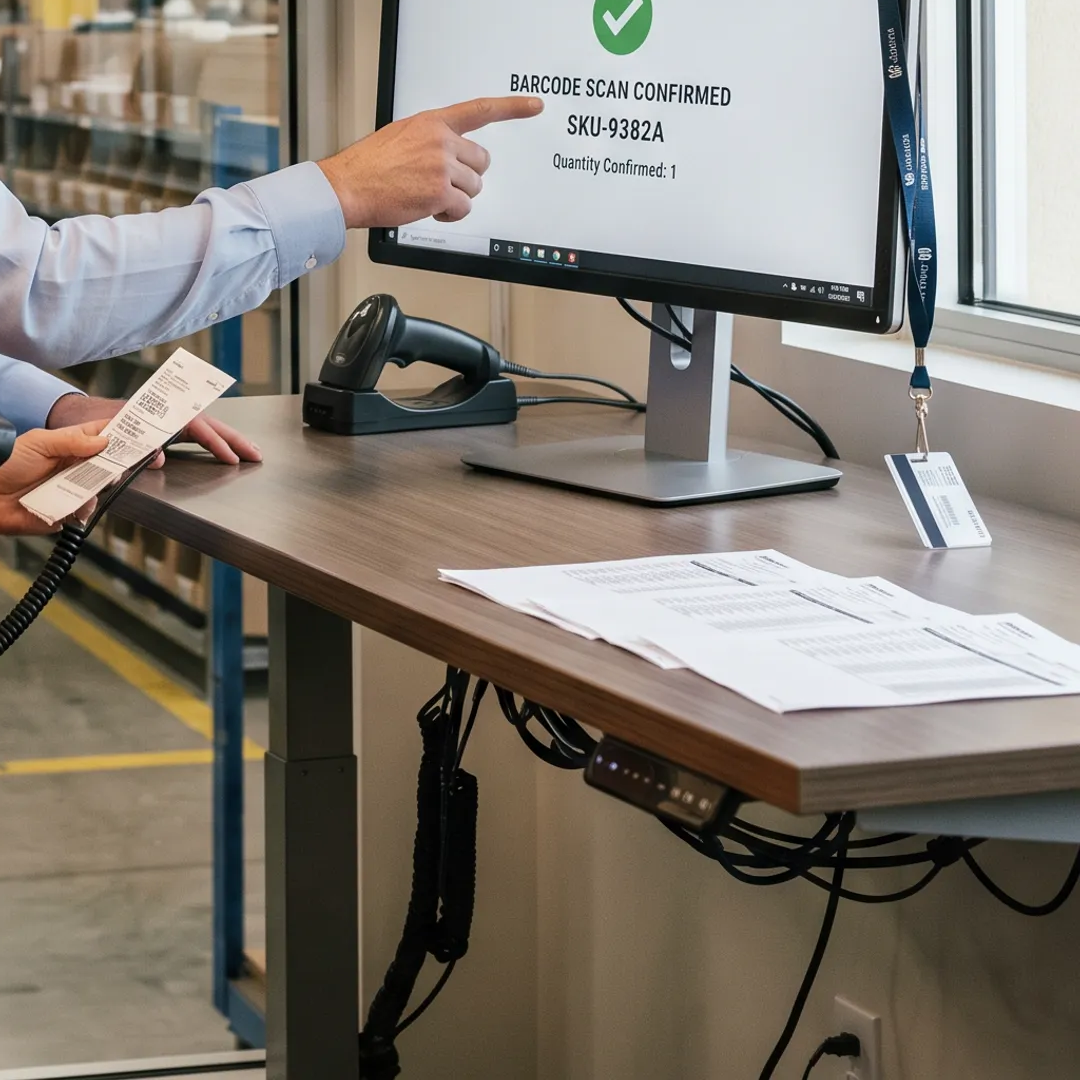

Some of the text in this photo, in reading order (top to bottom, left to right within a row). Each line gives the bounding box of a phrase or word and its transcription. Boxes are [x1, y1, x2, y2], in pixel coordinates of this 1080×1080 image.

[510, 74, 730, 106] BARCODE SCAN CONFIRMED
[567, 115, 664, 142] SKU-9382A
[553, 153, 675, 179] Quantity Confirmed: 1
